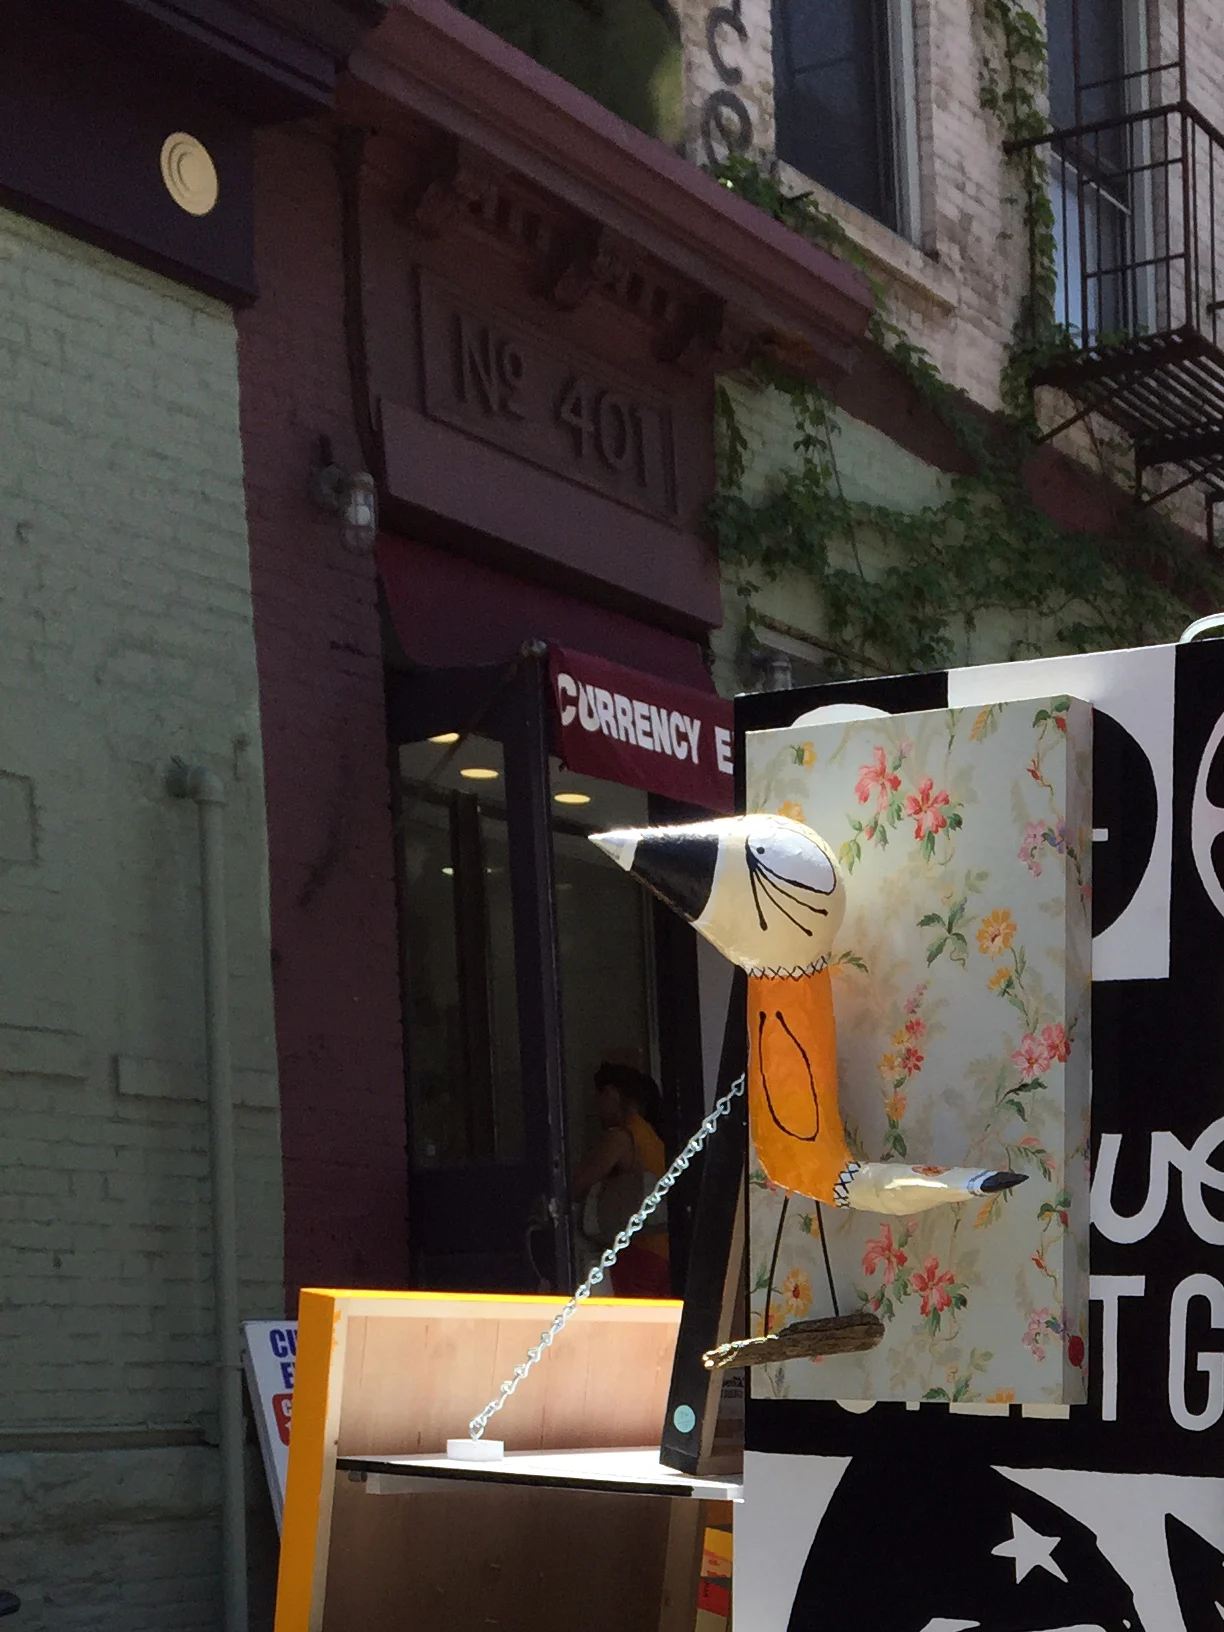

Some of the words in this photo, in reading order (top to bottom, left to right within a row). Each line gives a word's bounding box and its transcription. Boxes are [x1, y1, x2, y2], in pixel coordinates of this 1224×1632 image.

[553, 373, 648, 488] 401
[557, 672, 701, 764] CURRENCY
[714, 726, 735, 775] E
